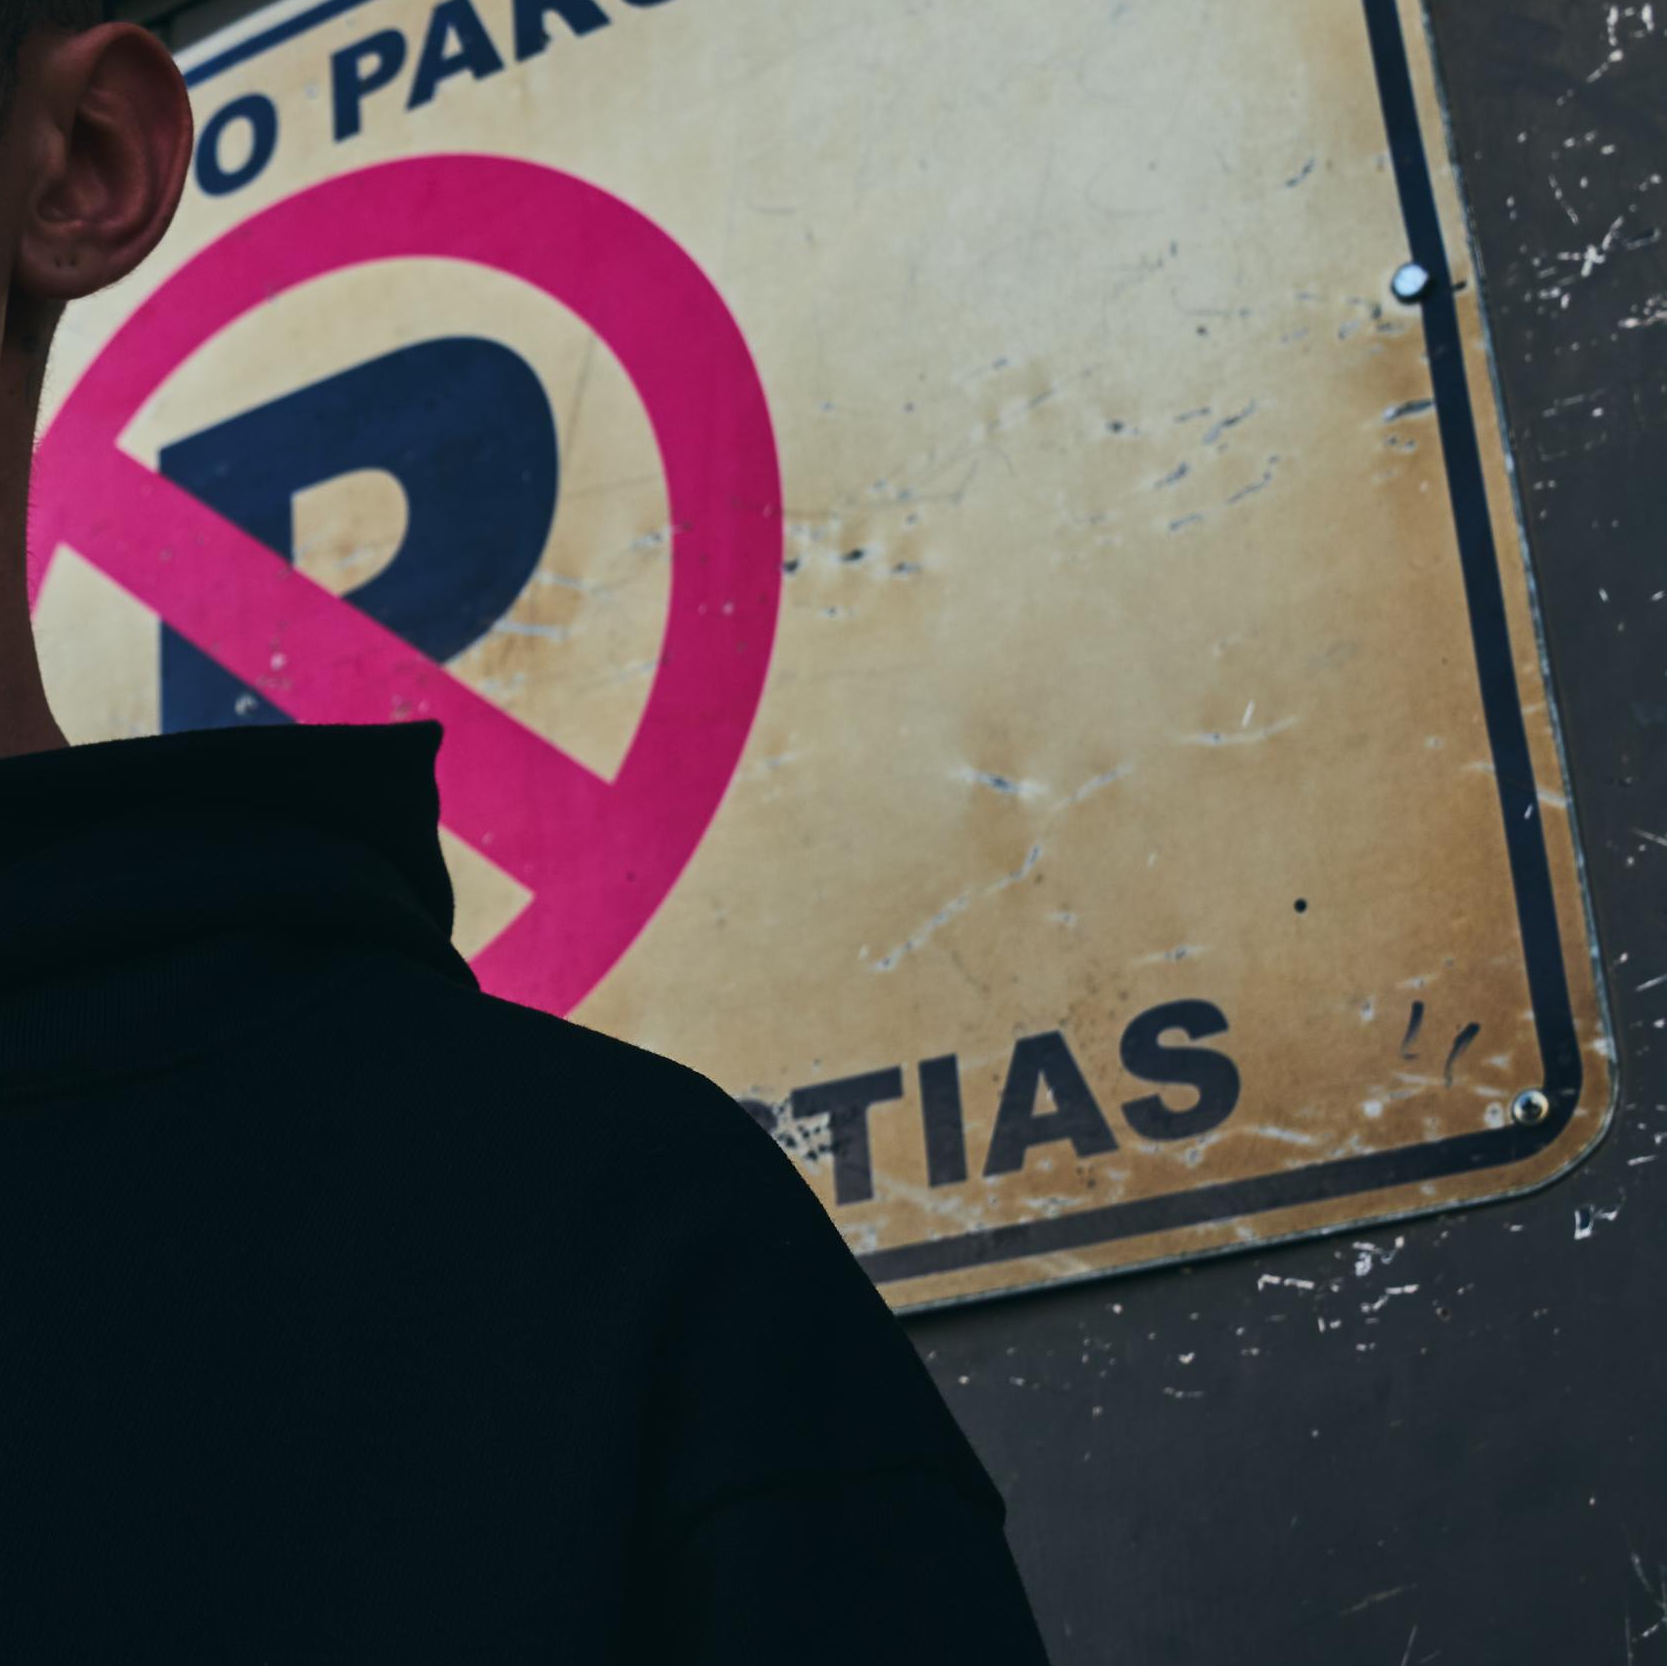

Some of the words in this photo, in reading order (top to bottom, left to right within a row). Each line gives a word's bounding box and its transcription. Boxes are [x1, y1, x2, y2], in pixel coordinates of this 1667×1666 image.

[194, 93, 278, 196] O
[158, 336, 559, 733] P
[742, 998, 1242, 1205] TIAS
